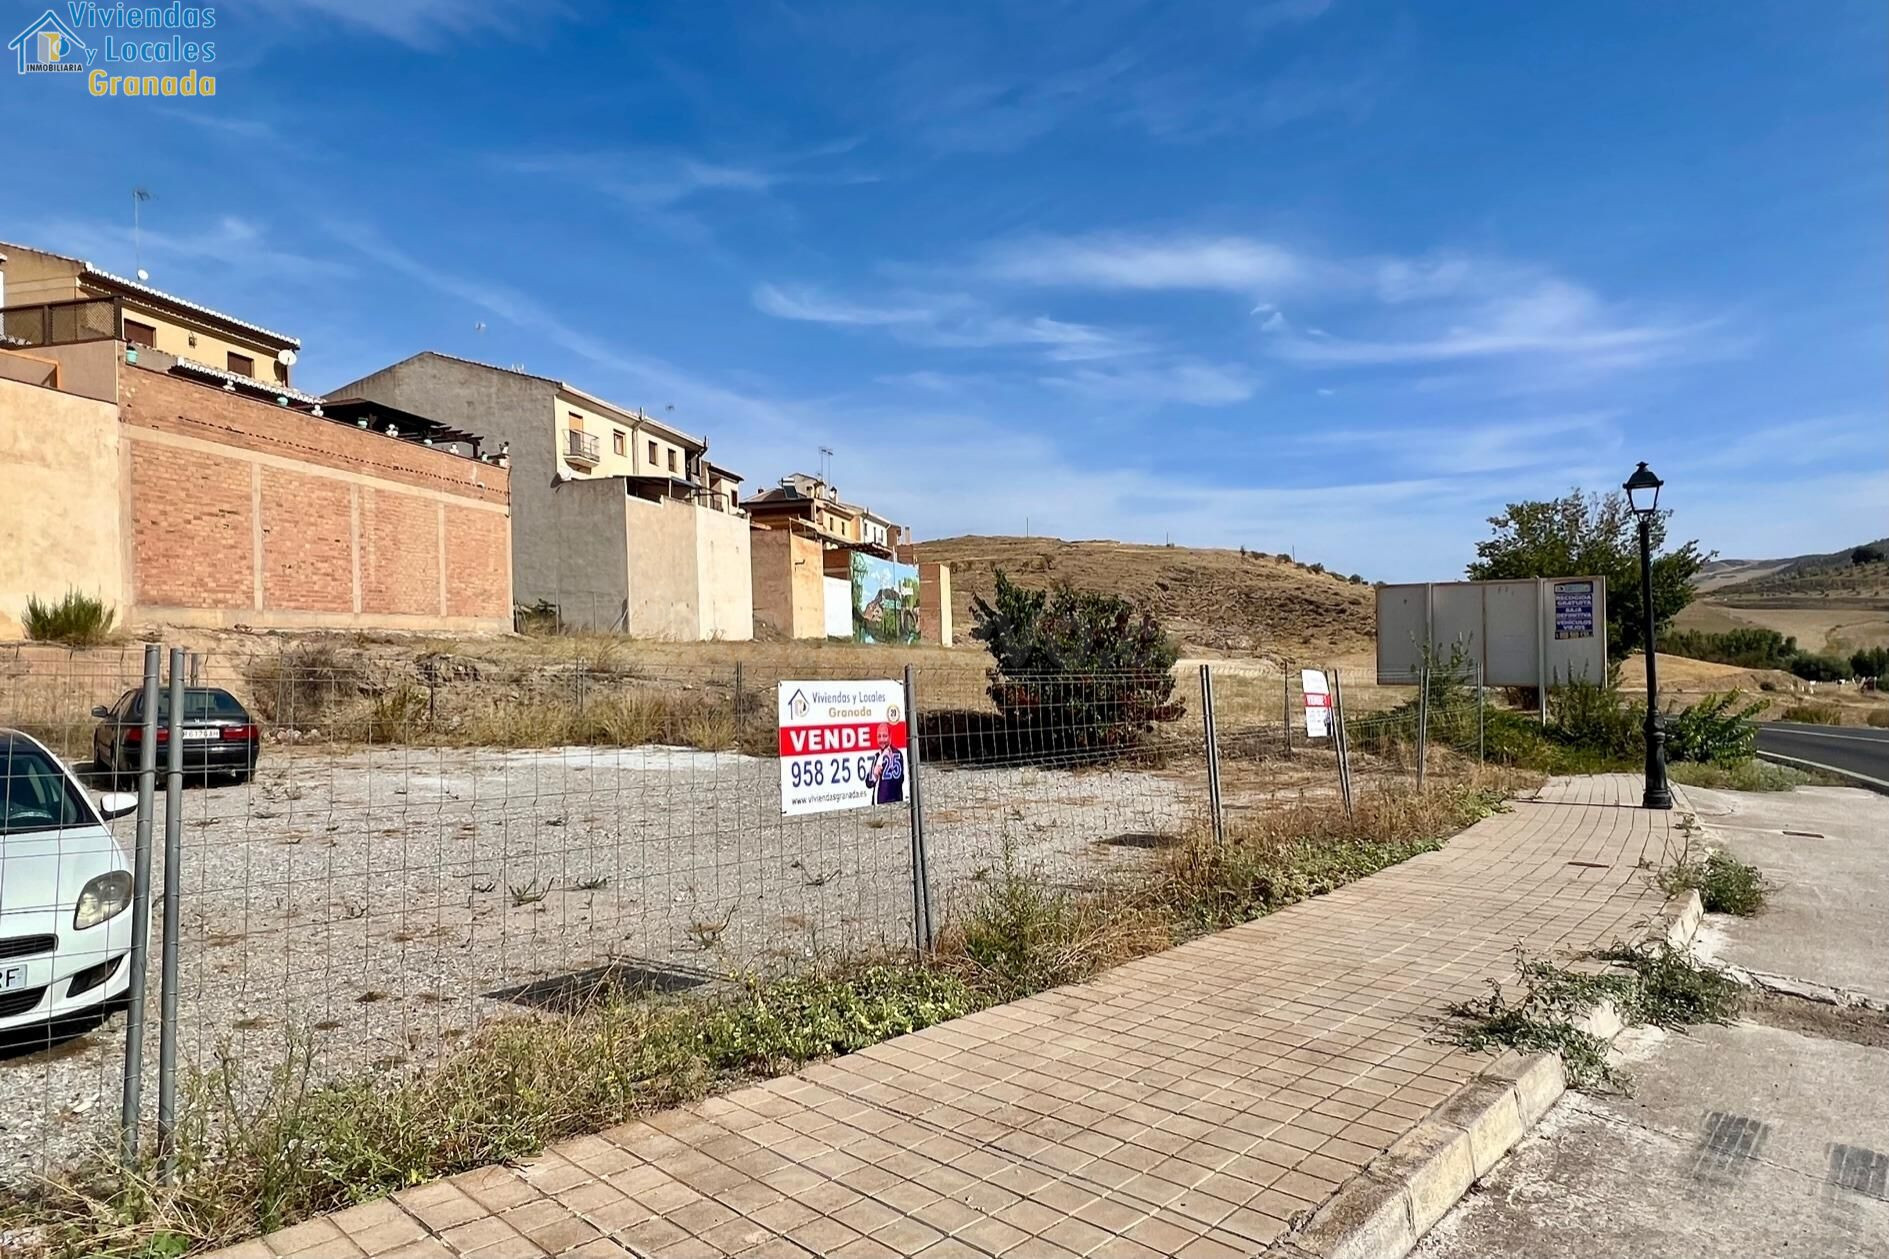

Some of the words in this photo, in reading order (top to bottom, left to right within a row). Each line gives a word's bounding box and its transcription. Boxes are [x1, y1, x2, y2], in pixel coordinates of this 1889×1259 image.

[812, 691, 850, 704] Viviendas
[853, 695, 857, 704] y
[859, 691, 886, 703] Locales
[828, 706, 872, 718] Granada
[789, 727, 871, 752] VENDE
[791, 759, 824, 788] 958
[830, 758, 851, 784] 25
[857, 756, 875, 782] 67
[882, 754, 902, 780] 25
